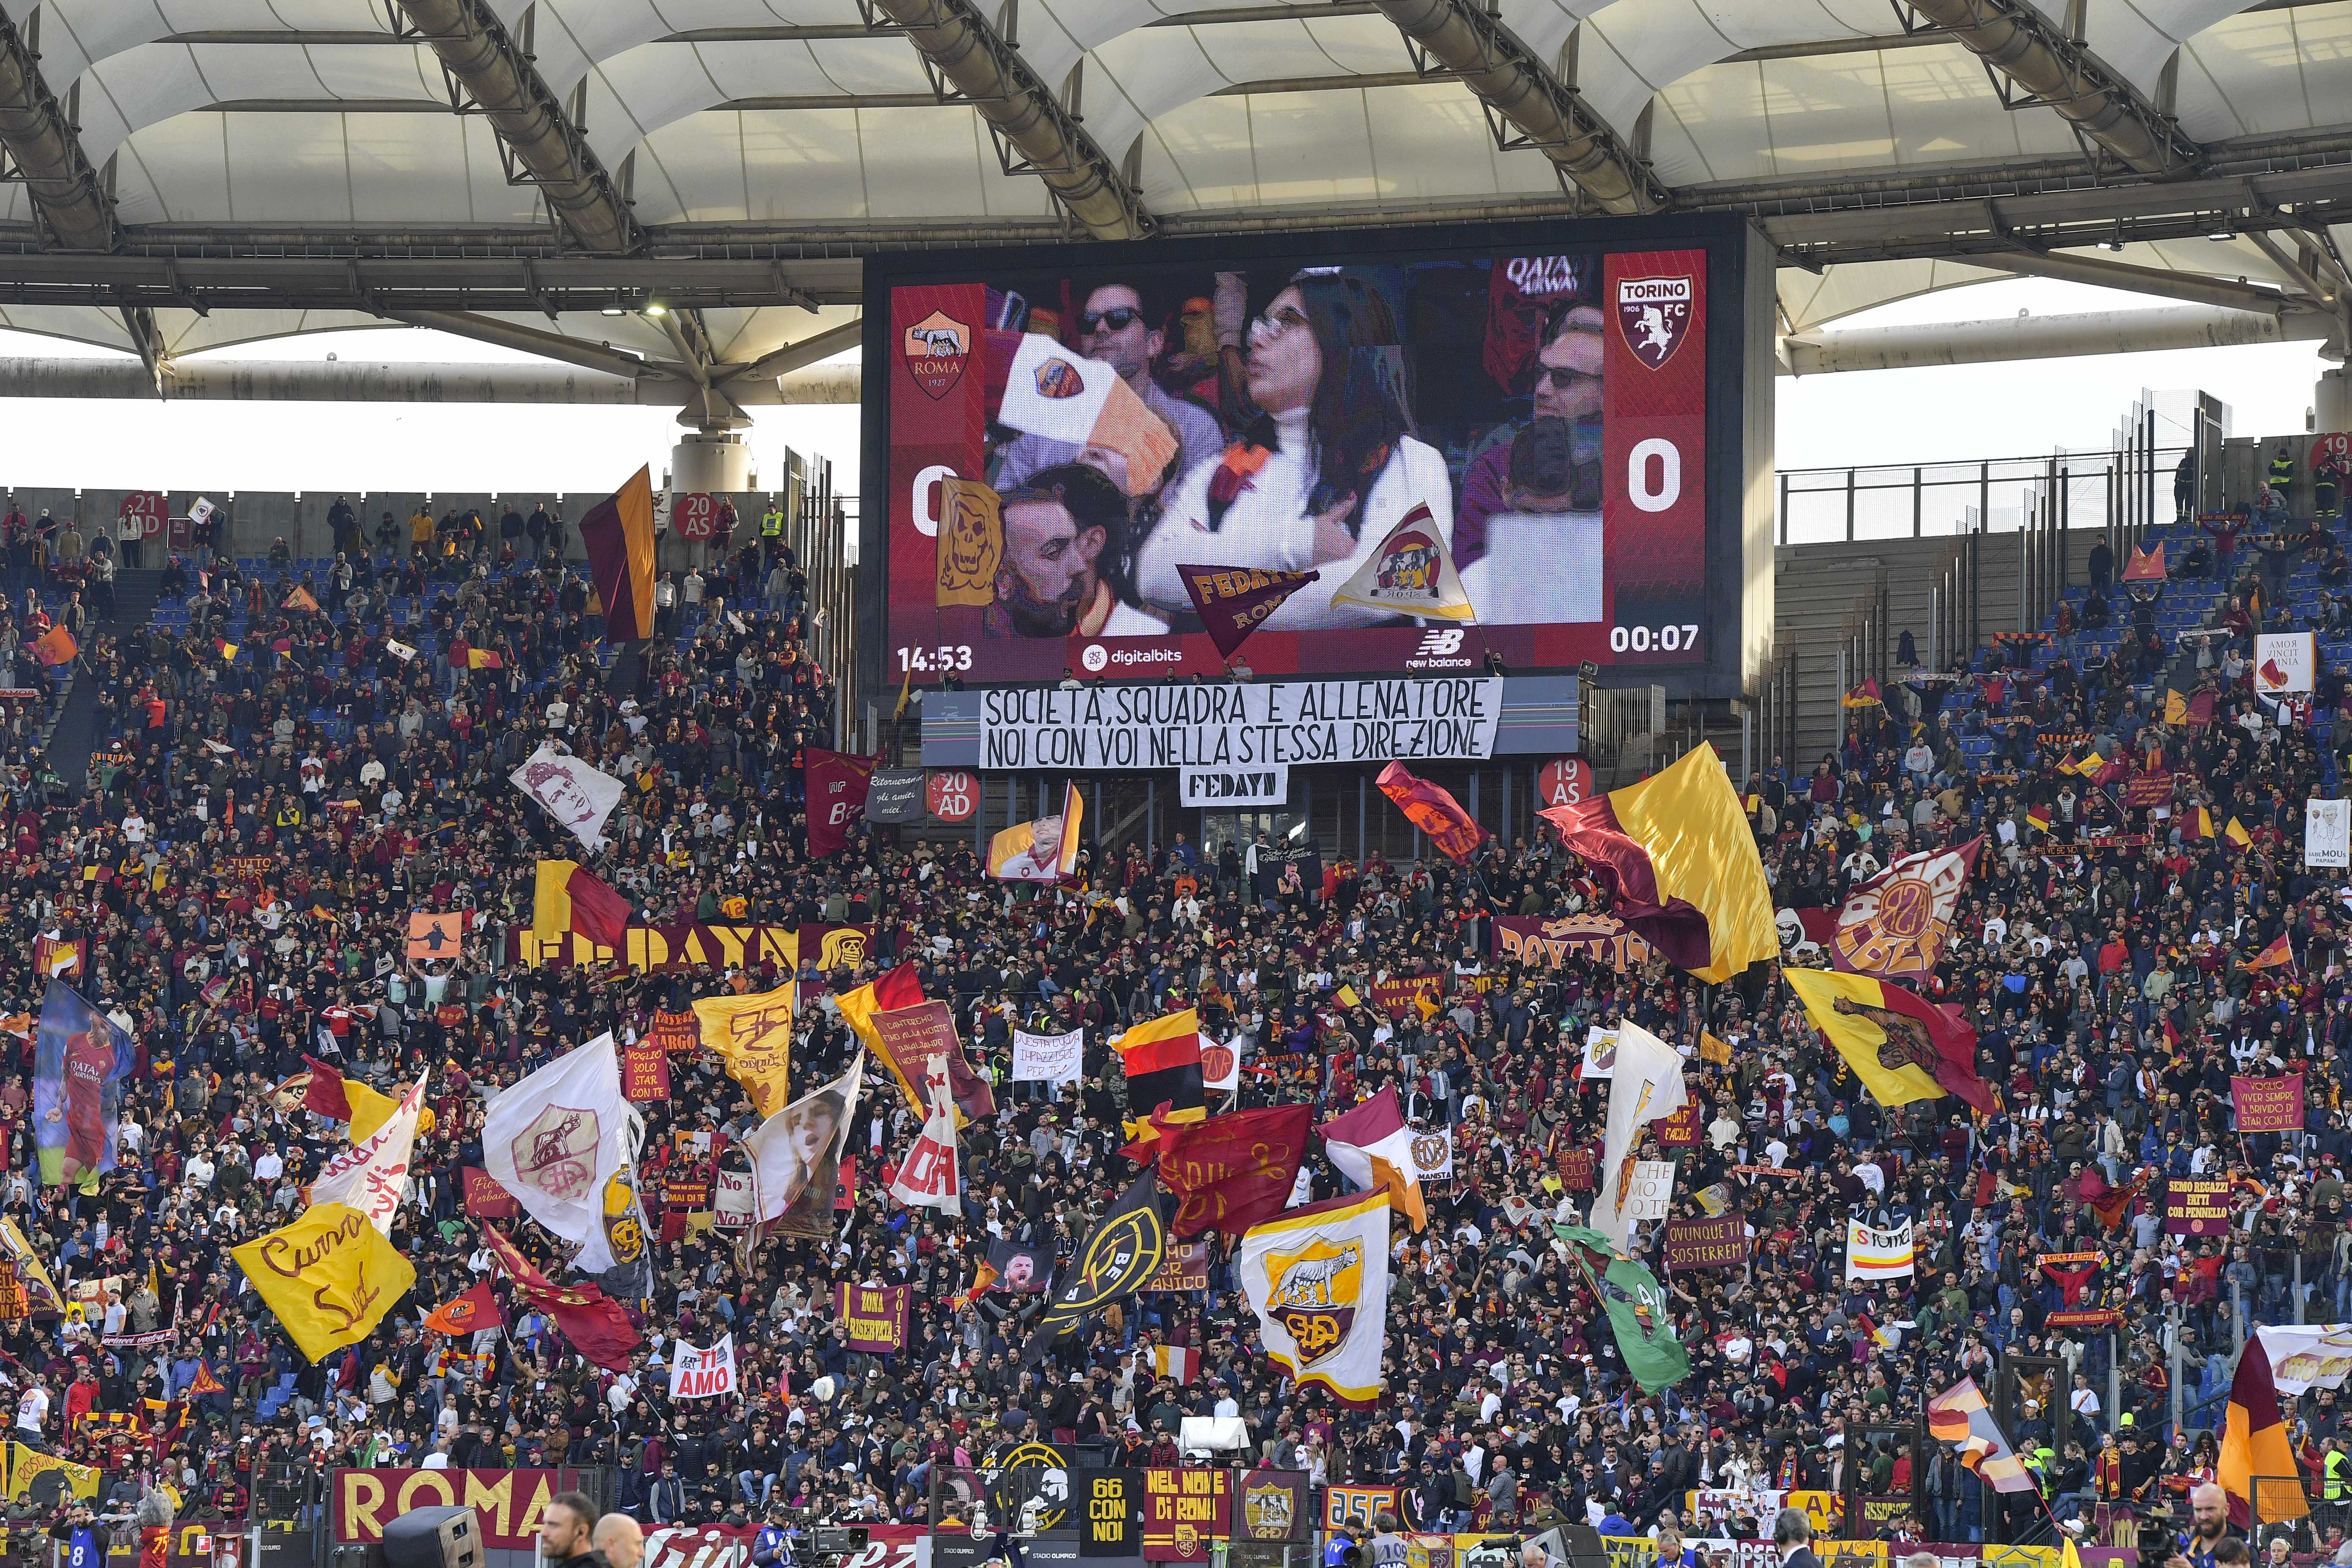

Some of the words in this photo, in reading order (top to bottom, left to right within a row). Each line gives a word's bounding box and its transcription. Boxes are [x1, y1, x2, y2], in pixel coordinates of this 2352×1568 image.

[1624, 282, 1686, 298] TORINO
[1664, 304, 1685, 316] FC
[915, 362, 959, 374] ROMA
[2325, 436, 2347, 455] 19
[1628, 438, 1680, 511] 0
[134, 495, 155, 513] 21
[686, 497, 710, 515] 20
[685, 517, 709, 536] AS
[1611, 624, 1699, 652] 00:07
[897, 645, 972, 672] 14:53
[1111, 649, 1182, 665] digitalbits
[1406, 658, 1426, 667] new
[1429, 656, 1471, 667] balance
[2267, 649, 2298, 658] VINCIT
[2274, 658, 2299, 666] MNIA
[1268, 685, 1285, 722] E
[1298, 679, 1490, 722] ALLENATORE
[988, 727, 1026, 768] NOI
[1036, 727, 1086, 765] CON
[1097, 727, 1138, 766] VOI
[1150, 726, 1231, 766] NELLA
[1237, 723, 1337, 764] STESSA
[1352, 719, 1487, 760] DIREZIONE
[1554, 759, 1578, 781] 19
[942, 771, 968, 792] 20
[1189, 773, 1276, 798] FEDAYN
[877, 793, 889, 803] gli
[892, 789, 916, 800] amici
[1552, 783, 1580, 805] AS
[938, 795, 970, 816] AD
[231, 858, 271, 868] TUTTO
[726, 901, 744, 917] 12
[1374, 979, 1400, 990] COR
[882, 1033, 900, 1042] FINO
[902, 1030, 921, 1040] ALLA
[1015, 1033, 1050, 1048] QUESTA
[1052, 1033, 1080, 1048] CURVA
[628, 1050, 662, 1060] VOGLIO
[1020, 1048, 1075, 1062] IMPAZZISCE
[634, 1062, 657, 1073] SOLO
[1026, 1065, 1045, 1077] PER
[74, 1070, 101, 1084] AIRWAYS
[635, 1075, 658, 1085] STAR
[631, 1088, 650, 1097] CON
[653, 1086, 664, 1097] TE
[2250, 1081, 2284, 1091] VOGLIO
[2240, 1093, 2265, 1102] VIVER
[2265, 1091, 2295, 1102] SEMPRE
[2241, 1105, 2248, 1114] IL
[2249, 1104, 2284, 1113] BRIVIDO
[2286, 1103, 2293, 1112] DI
[2242, 1116, 2261, 1126] STAR
[2263, 1116, 2282, 1125] CON
[2285, 1115, 2293, 1124] TE
[1409, 1124, 1449, 1136] TRADIZIONE
[1664, 1127, 1691, 1141] FACILE
[1555, 1149, 1587, 1163] SIAMO
[1559, 1163, 1587, 1176] SOLO
[1634, 1163, 1671, 1179] CHE
[723, 1173, 746, 1191] No
[1563, 1178, 1583, 1188] NOI
[2168, 1181, 2192, 1193] SEMO
[2194, 1181, 2229, 1193] REGAZZI
[669, 1194, 687, 1202] MAI
[687, 1194, 696, 1202] DI
[697, 1193, 705, 1202] TE
[2187, 1194, 2210, 1206] FATTI
[719, 1209, 743, 1225] No
[2167, 1206, 2183, 1217] COR
[2186, 1206, 2227, 1218] PENNELLO
[1670, 1224, 1724, 1242] OVUNQUE
[1727, 1220, 1740, 1237] TI
[1850, 1227, 1869, 1245] as
[1872, 1227, 1911, 1248] roma
[260, 1213, 364, 1277] Curva
[1672, 1242, 1742, 1264] SOSTERREM
[82, 1285, 92, 1293] 22
[861, 1291, 885, 1313] ZONA
[87, 1307, 99, 1315] 1927
[2053, 1313, 2076, 1322] CAMMINERÒ
[2077, 1312, 2096, 1321] INSIEME
[850, 1318, 893, 1342] RISERVATA
[697, 1348, 716, 1369] TI
[677, 1367, 728, 1395] AMO
[1093, 1478, 1123, 1498] 66
[1147, 1471, 1178, 1494] NEL
[1181, 1472, 1225, 1494] NOME
[345, 1469, 552, 1540] ROMA
[1089, 1499, 1127, 1519] CON
[1177, 1497, 1216, 1521] ROMA
[1093, 1521, 1124, 1542] NOI
[1329, 1543, 1342, 1552] TV
[1383, 1542, 1408, 1559] 109
[72, 1546, 84, 1566] 8
